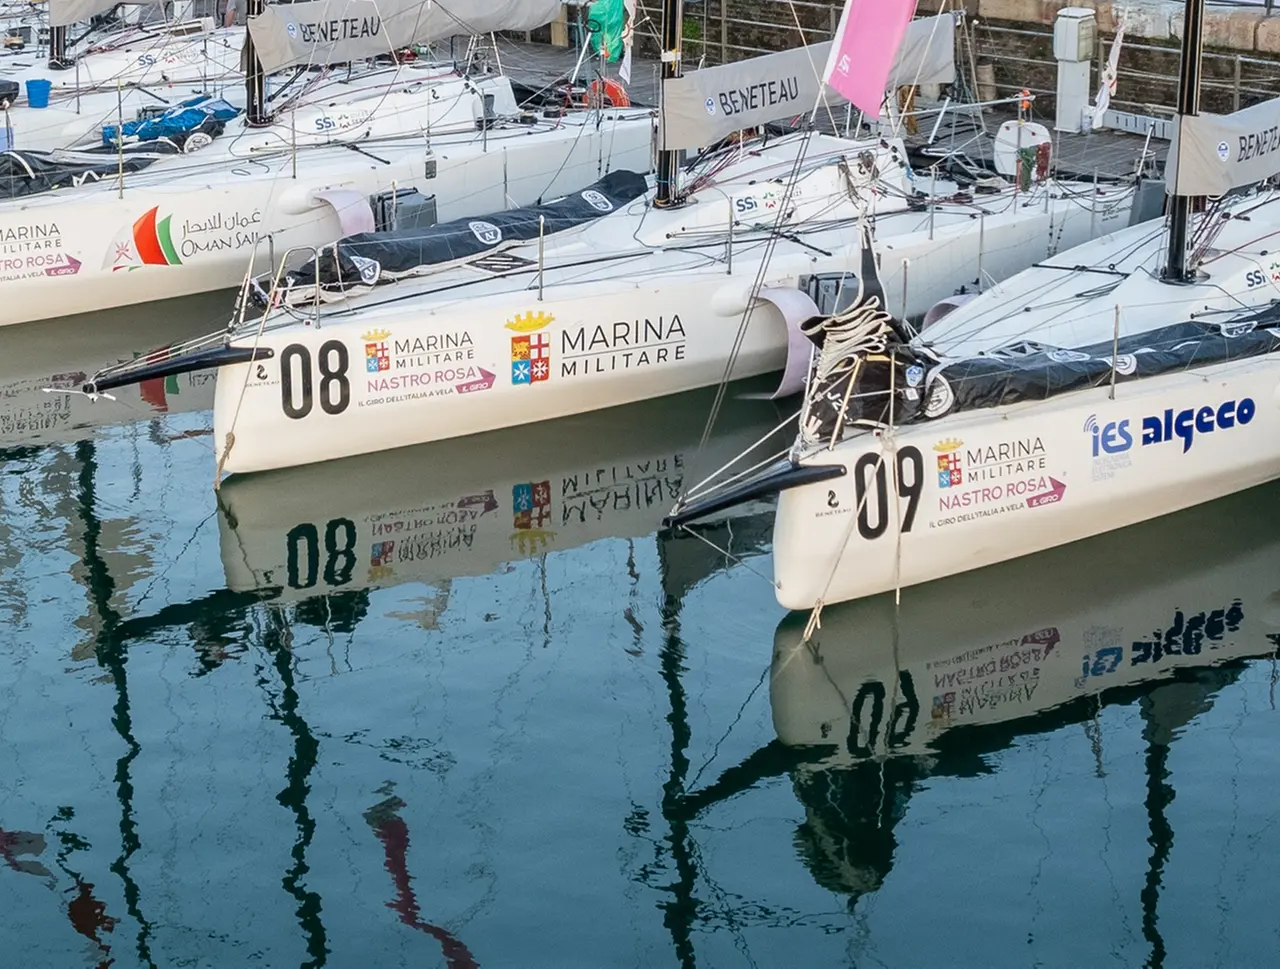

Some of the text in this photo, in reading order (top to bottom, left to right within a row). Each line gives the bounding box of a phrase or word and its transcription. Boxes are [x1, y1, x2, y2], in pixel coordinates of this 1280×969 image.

[298, 16, 382, 42] BENETEAU
[719, 76, 799, 116] BENETEAU
[26, 253, 64, 267] ROSA
[26, 270, 45, 279] VELA
[394, 331, 474, 356] MARINA
[561, 314, 686, 354] MARINA
[395, 348, 475, 369] MILITARE
[561, 344, 686, 378] MILITARE
[280, 339, 351, 420] 08
[367, 366, 476, 393] NASTRO ROSA
[469, 382, 489, 391] GIRO
[366, 398, 385, 407] GIRO
[385, 391, 428, 403] DELL'ITALIA
[435, 387, 454, 396] VELA
[1142, 397, 1256, 454] algeco
[966, 437, 1045, 467] MARINA
[968, 458, 1046, 483] MILITARE
[854, 445, 925, 540] 09
[939, 476, 1048, 512] NASTRO ROSA
[1032, 493, 1059, 506] IL GIRO
[929, 519, 936, 528] IL
[937, 516, 956, 528] GIRO
[957, 508, 998, 523] DELL'ITALIA
[1005, 502, 1025, 513] VELA
